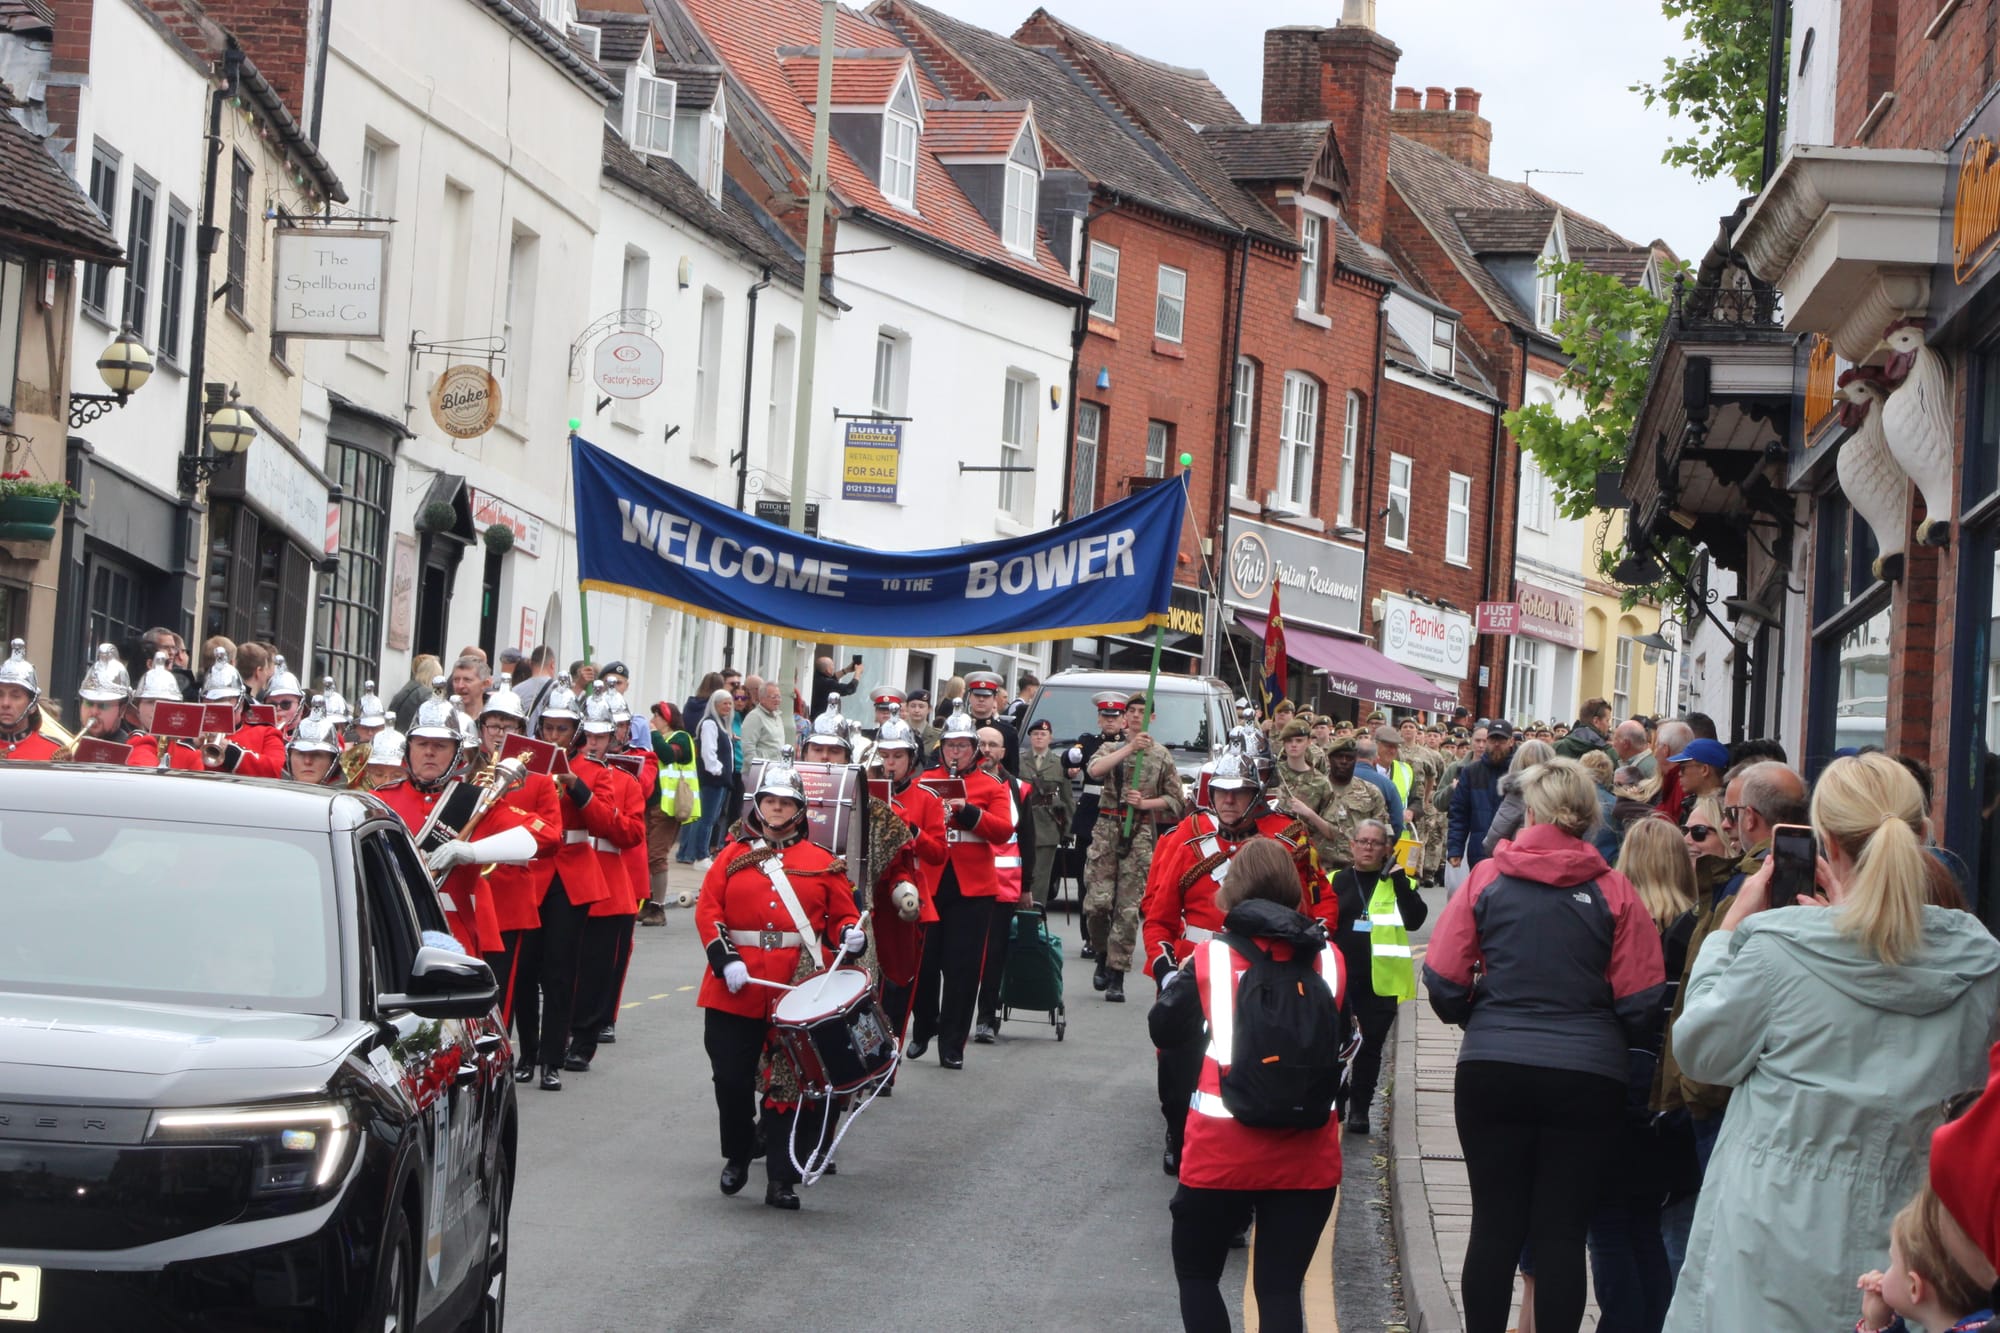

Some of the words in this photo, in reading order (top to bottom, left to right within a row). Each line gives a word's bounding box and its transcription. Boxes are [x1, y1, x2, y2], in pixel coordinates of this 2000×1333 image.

[313, 250, 348, 267] The
[284, 274, 376, 294] Spellbound
[291, 302, 335, 319] Bead
[339, 304, 367, 321] Co
[602, 374, 631, 388] Factory
[631, 376, 656, 387] Specs
[440, 388, 490, 410] Blokes
[849, 426, 897, 434] BURLEY
[849, 453, 873, 461] RETAIL
[847, 466, 867, 476] FOR
[869, 468, 895, 477] SALE
[846, 484, 861, 492] 0121
[863, 485, 875, 493] 321
[876, 486, 894, 494] 3441
[617, 498, 848, 597] WELCOME
[881, 578, 900, 591] TO
[902, 578, 933, 592] THE
[964, 528, 1136, 599] BOWER
[1236, 554, 1264, 590] Goli
[1272, 559, 1306, 589] Italian
[1306, 565, 1359, 601] Restaurant
[1483, 605, 1513, 616] JUST
[1518, 589, 1556, 621] Golden
[1409, 609, 1445, 641] Paprika
[1490, 616, 1513, 627] EAT
[1375, 688, 1392, 699] 01543
